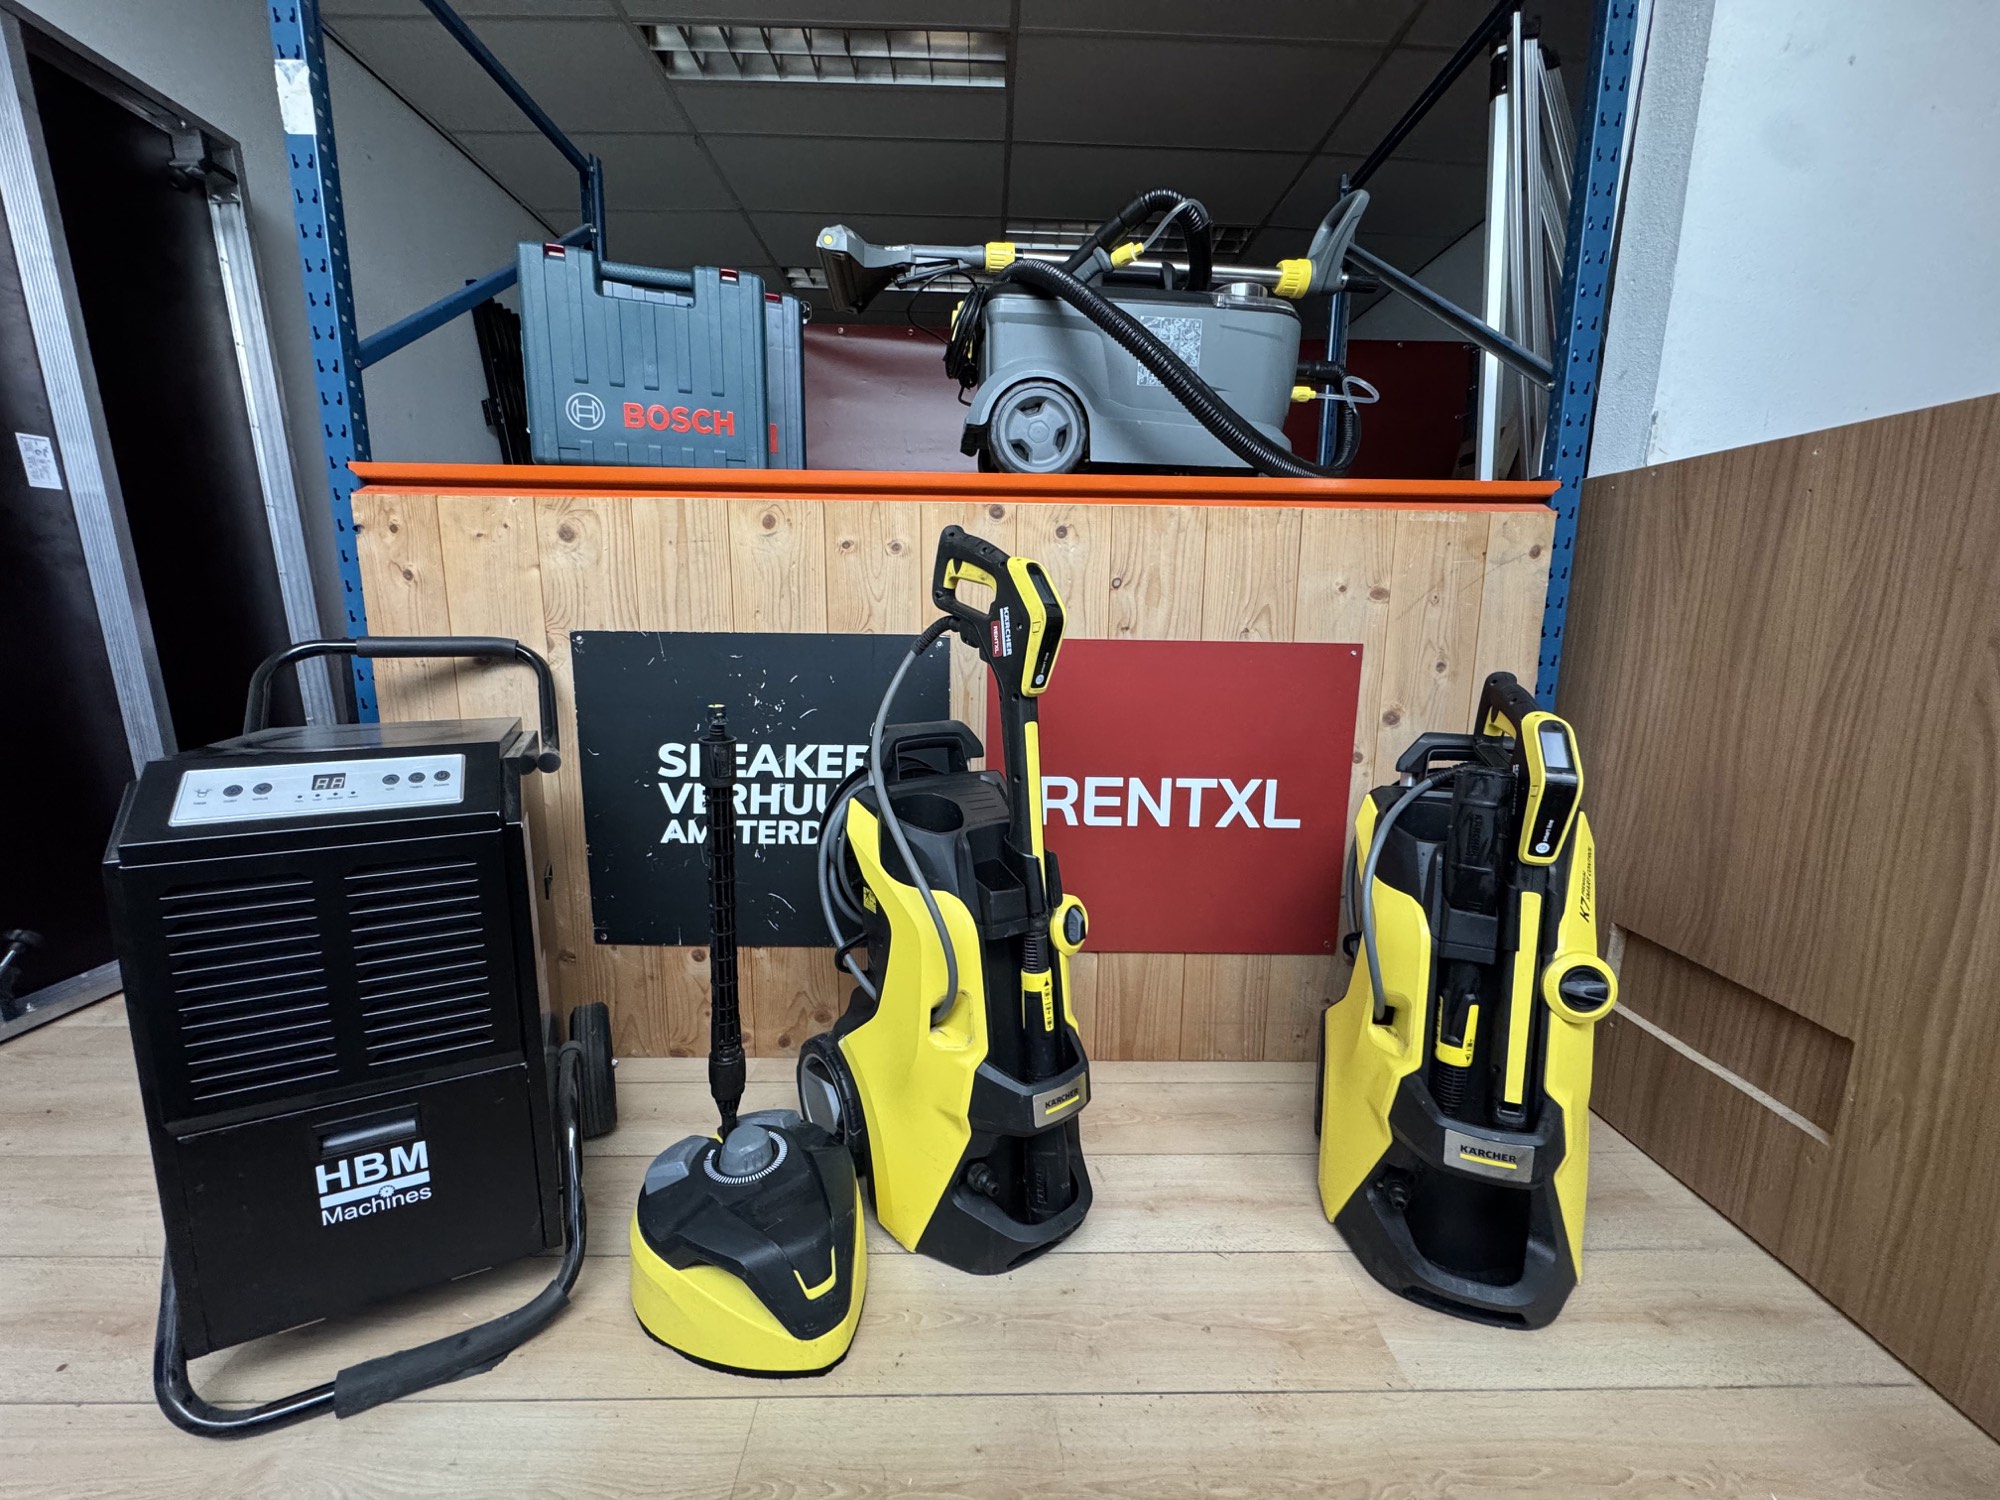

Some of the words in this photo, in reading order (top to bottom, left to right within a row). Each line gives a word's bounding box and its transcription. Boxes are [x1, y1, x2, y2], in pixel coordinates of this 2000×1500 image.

[623, 402, 735, 436] BOSCH
[1041, 776, 1301, 829] RENTXL
[315, 1140, 429, 1194] HBM
[321, 1186, 432, 1226] Machines
